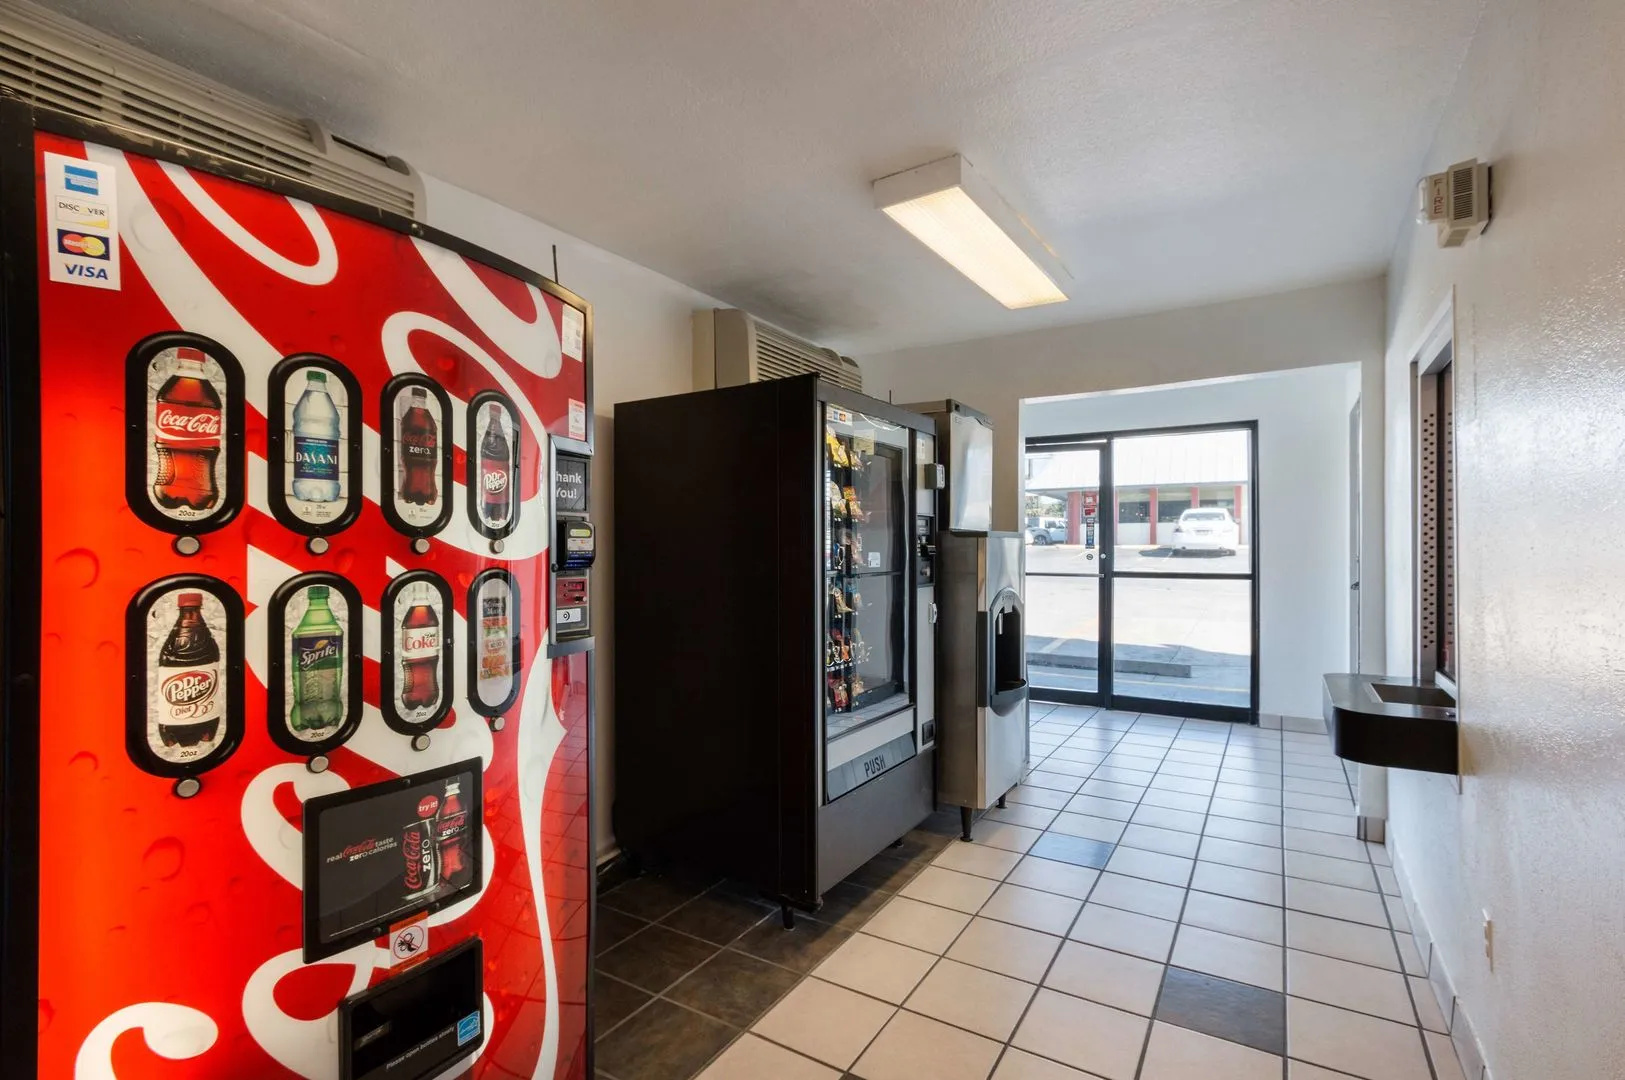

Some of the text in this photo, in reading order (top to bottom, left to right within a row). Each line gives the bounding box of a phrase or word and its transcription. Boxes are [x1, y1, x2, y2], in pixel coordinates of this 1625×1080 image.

[1433, 178, 1444, 215] FIRE
[64, 262, 109, 280] VISA
[158, 409, 220, 434] Coca-Cola
[295, 450, 338, 465] DASANI
[491, 471, 502, 481] Dr
[555, 470, 583, 484] hank
[178, 509, 197, 517] 20oz
[404, 635, 435, 651] Coke
[300, 645, 336, 665] Sprite
[170, 679, 211, 702] Pepper
[183, 676, 202, 689] Dr
[175, 705, 192, 716] Diet
[180, 750, 198, 758] 20oz
[864, 754, 886, 777] PUSH
[418, 804, 430, 813] try
[442, 826, 459, 836] zero
[326, 852, 343, 863] real
[376, 837, 394, 847] taste
[349, 842, 398, 862] zero calories
[422, 839, 432, 873] zero
[403, 831, 423, 889] Coca-Cola
